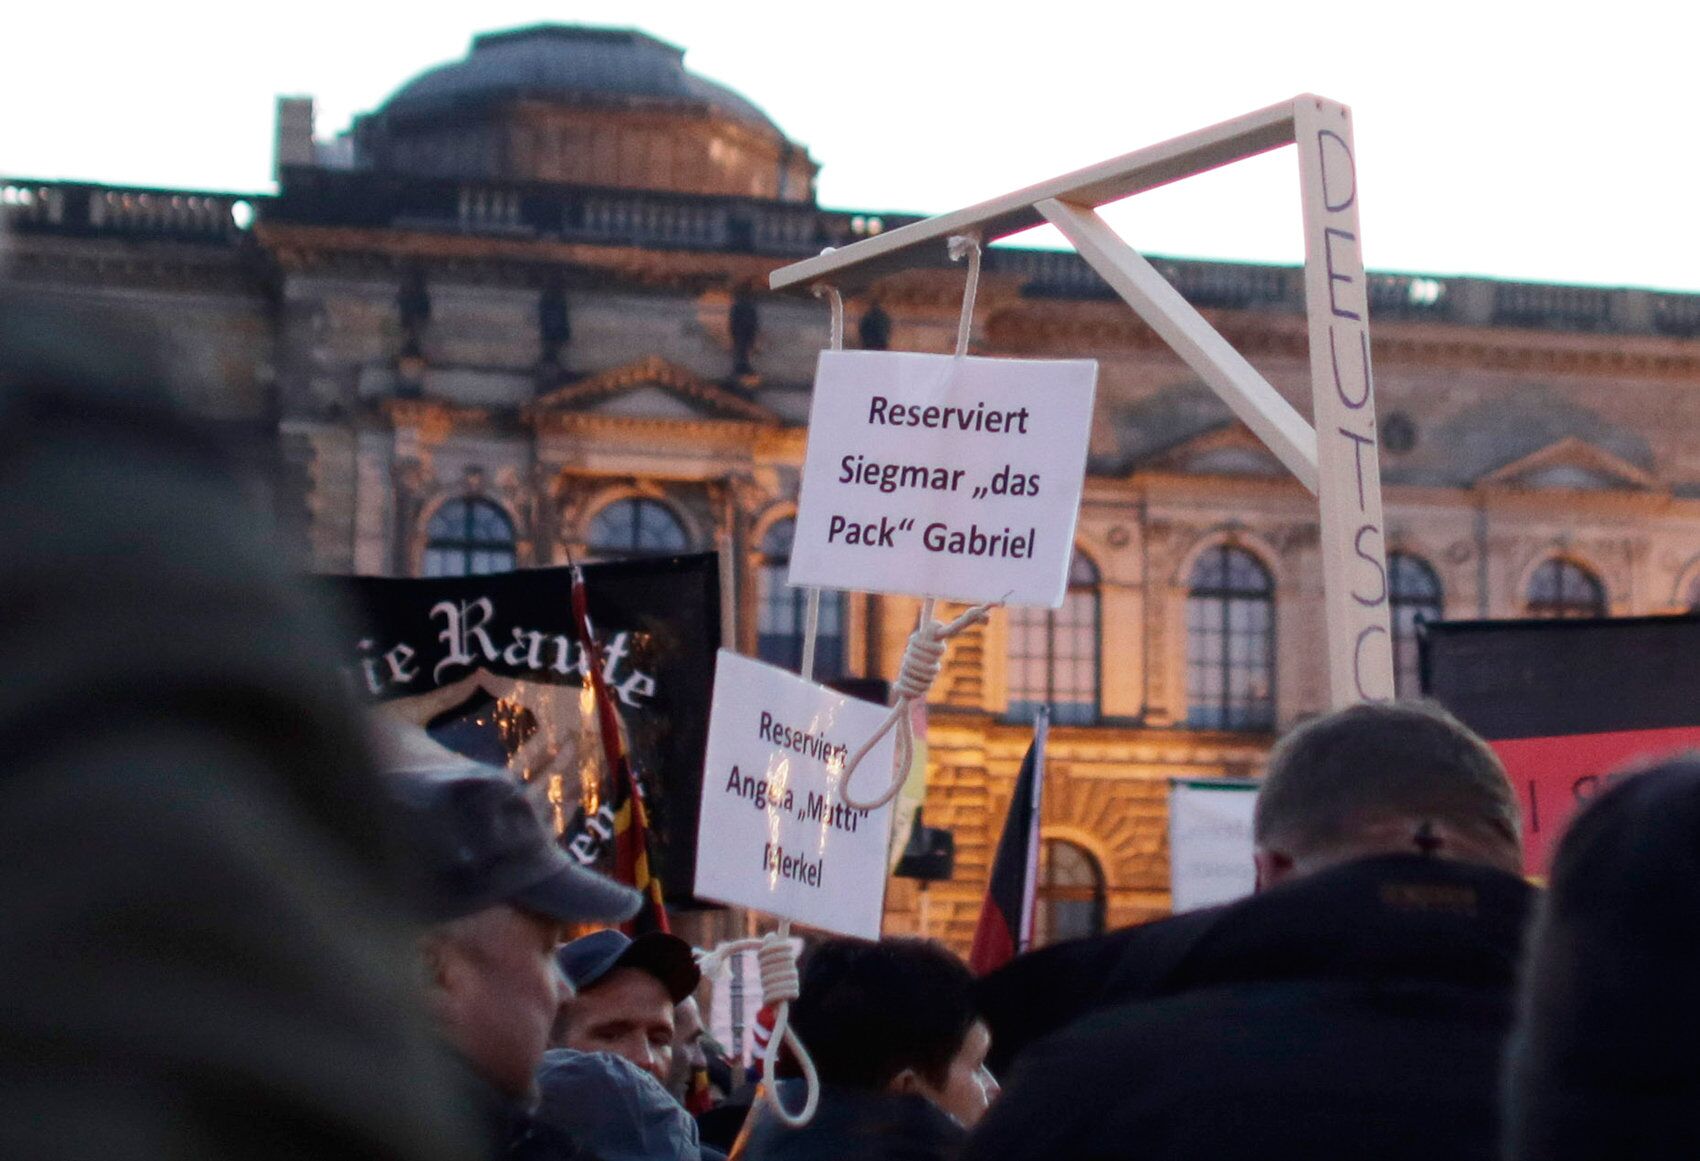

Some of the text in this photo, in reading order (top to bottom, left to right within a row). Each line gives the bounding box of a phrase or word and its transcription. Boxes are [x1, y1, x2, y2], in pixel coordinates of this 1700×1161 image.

[868, 396, 1029, 434] Reserviert
[838, 455, 1040, 499] Siegmar „das
[828, 515, 1036, 559] Pack“ Gabriel
[357, 596, 656, 709] ie Raute
[763, 842, 823, 888] Merkel
